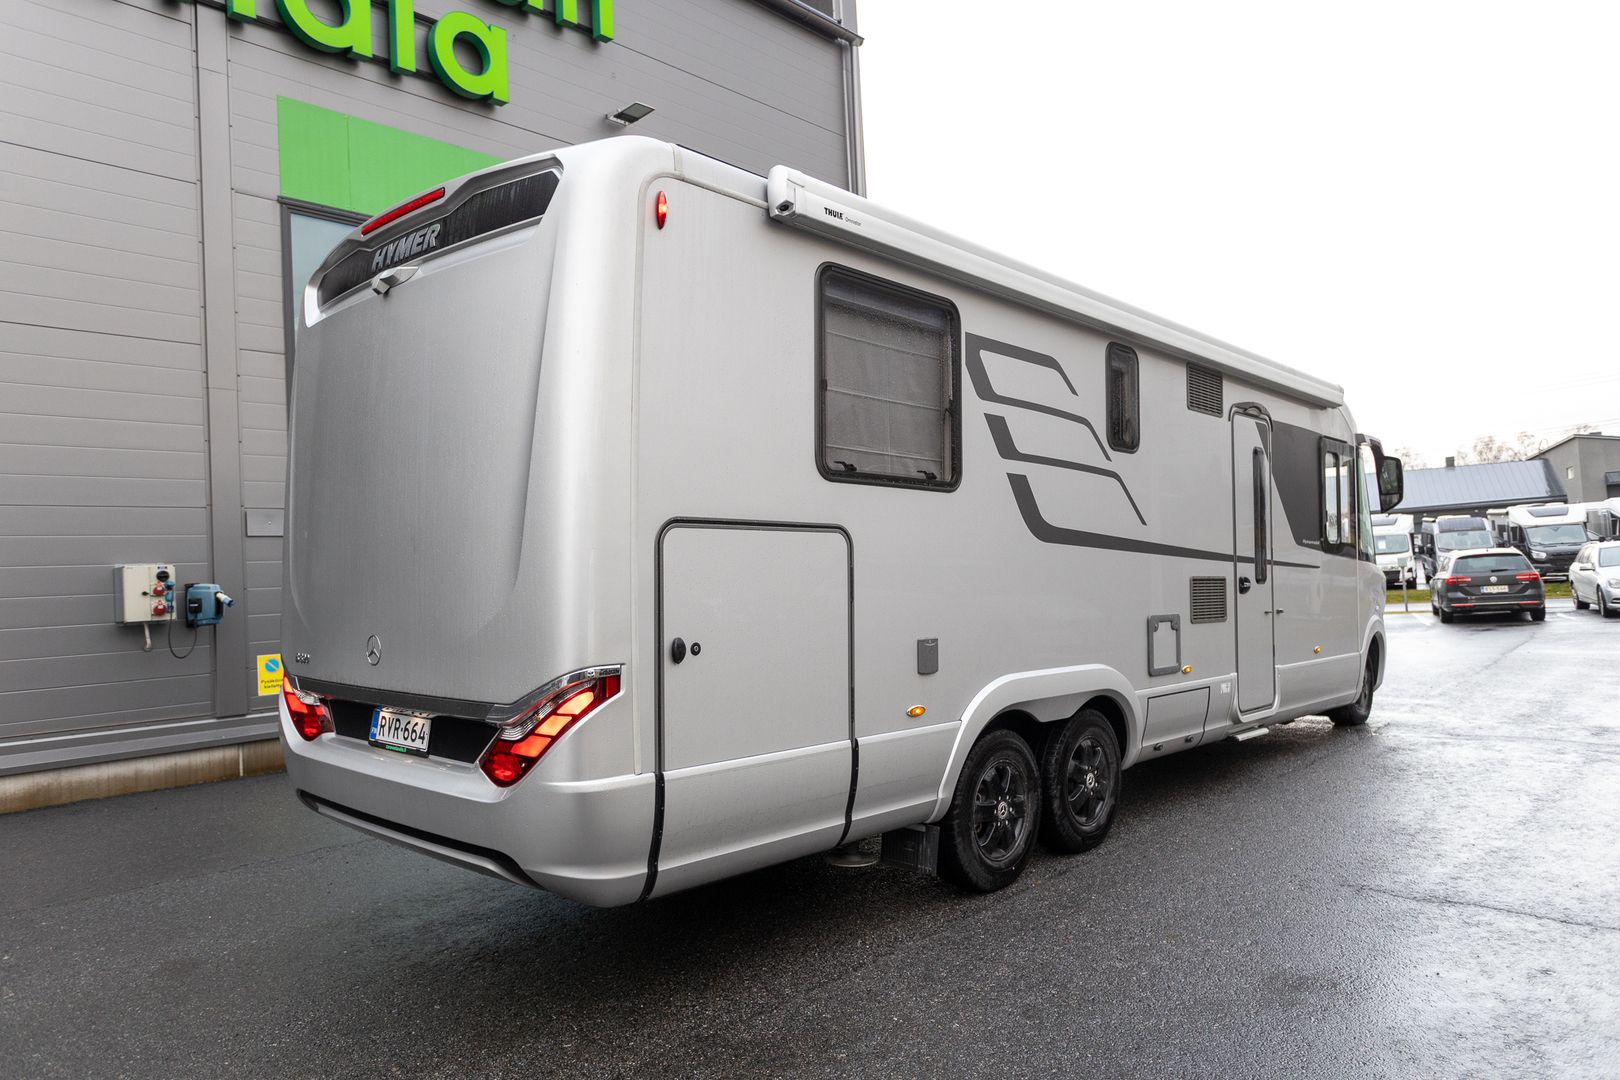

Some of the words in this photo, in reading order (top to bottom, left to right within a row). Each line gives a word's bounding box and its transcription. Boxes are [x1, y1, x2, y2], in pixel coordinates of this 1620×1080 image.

[824, 207, 843, 220] THULE
[371, 223, 442, 273] HYMER
[378, 716, 426, 744] RVR-664
